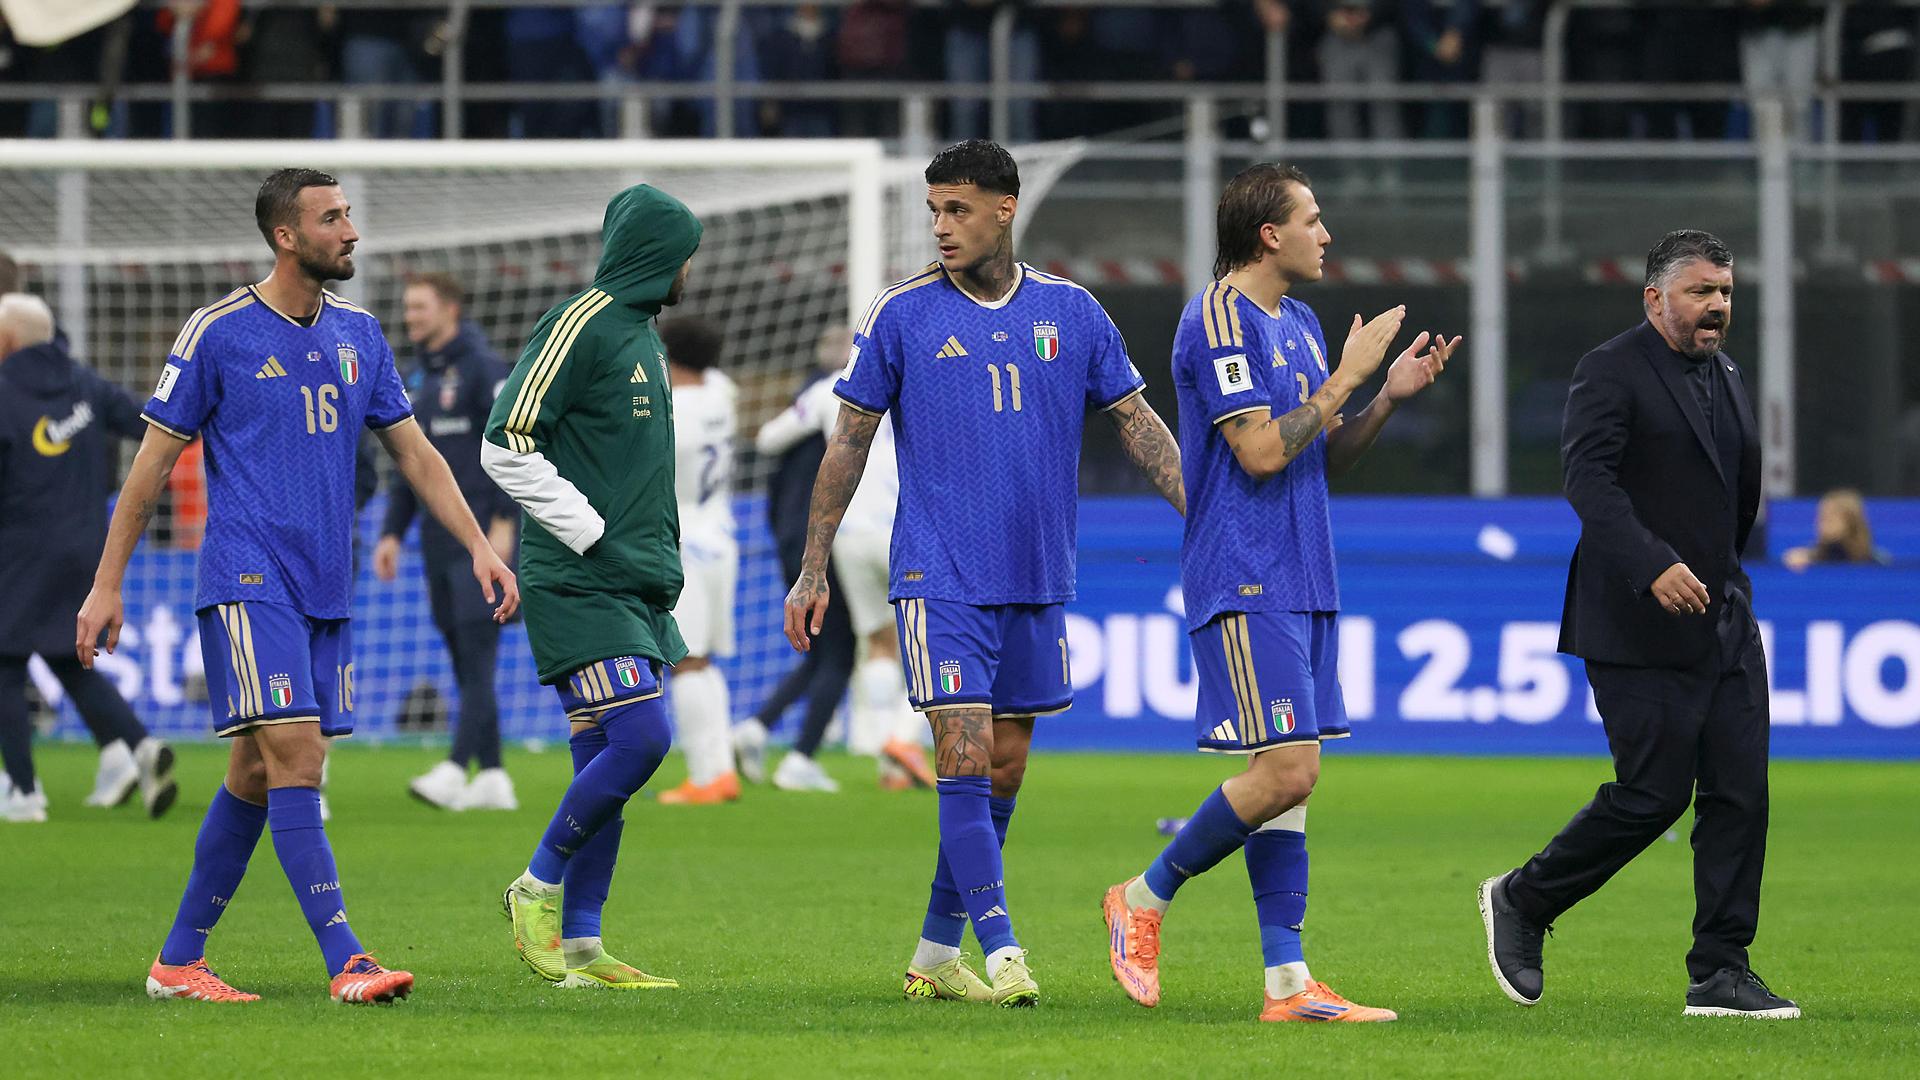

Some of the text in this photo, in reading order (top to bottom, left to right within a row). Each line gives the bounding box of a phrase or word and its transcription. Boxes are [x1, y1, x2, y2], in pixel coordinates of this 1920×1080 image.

[1036, 328, 1056, 336] ITALIA
[300, 383, 339, 435] 16
[987, 363, 1022, 412] 11
[1397, 617, 1571, 724] 2.5
[211, 895, 231, 907] ITA
